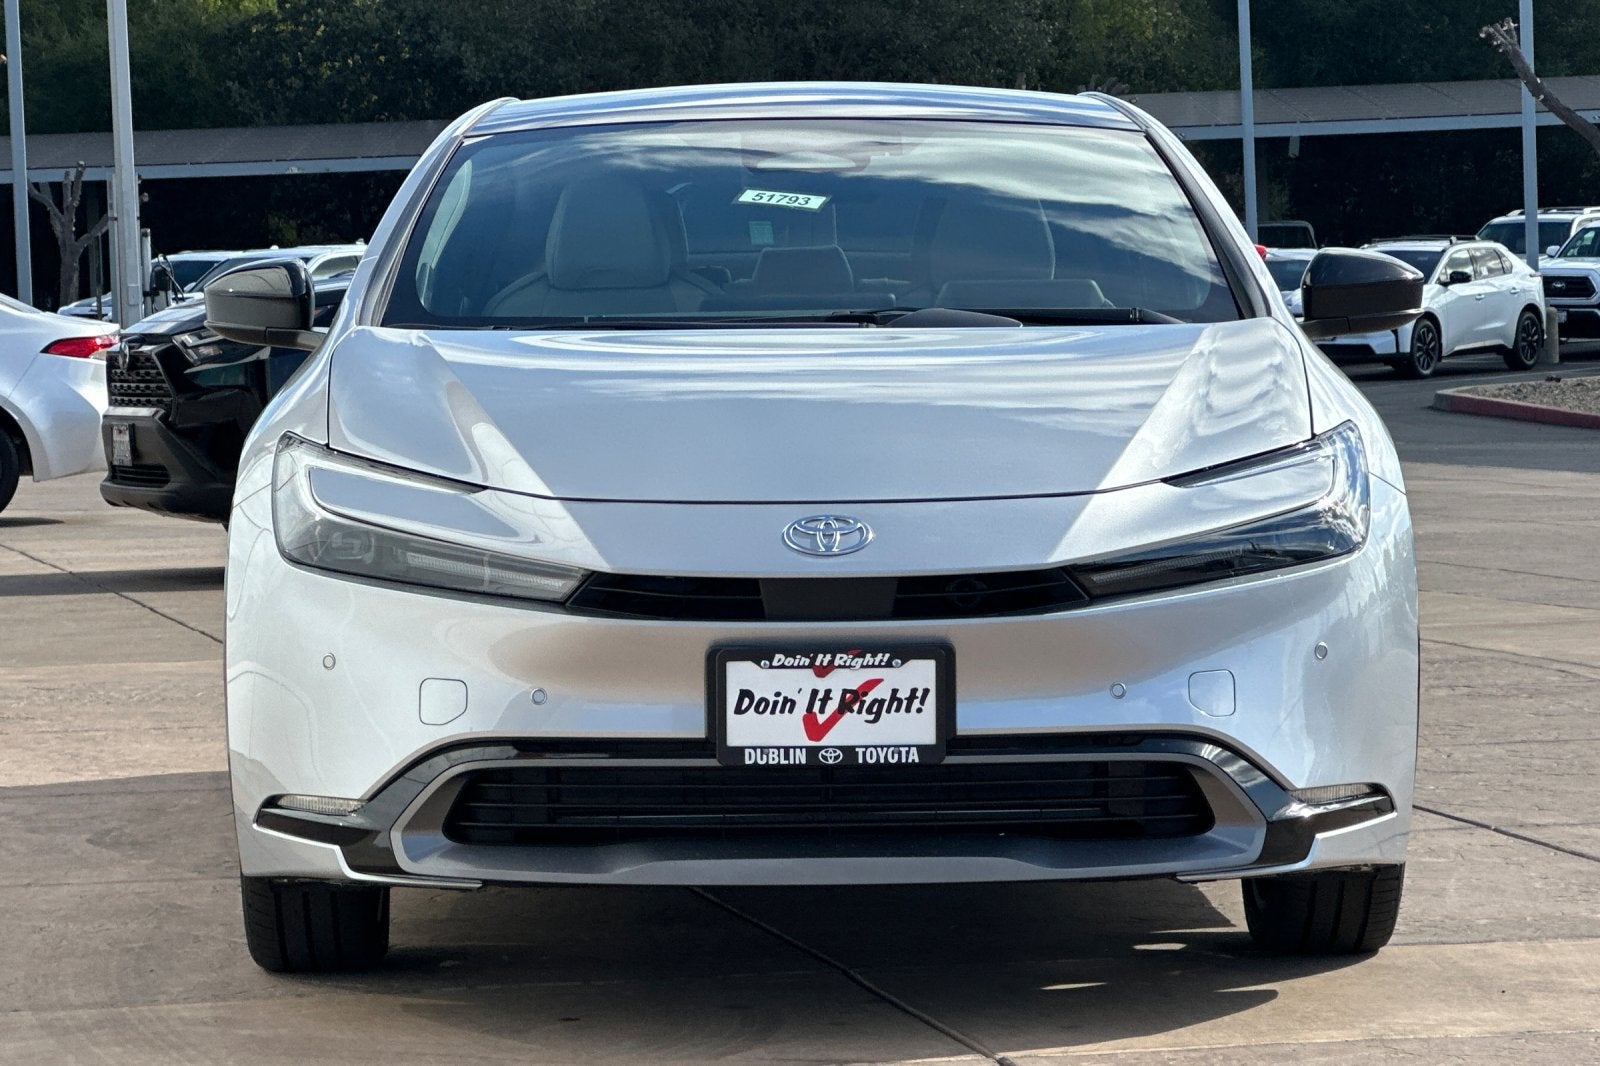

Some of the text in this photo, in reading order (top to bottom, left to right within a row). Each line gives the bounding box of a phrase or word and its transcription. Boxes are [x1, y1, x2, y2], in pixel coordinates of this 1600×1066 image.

[752, 192, 811, 206] 51793
[772, 653, 890, 670] Doin' It Right!
[733, 687, 931, 724] Doin' It Right!
[744, 747, 919, 765] DUBLIN TOYOTA
